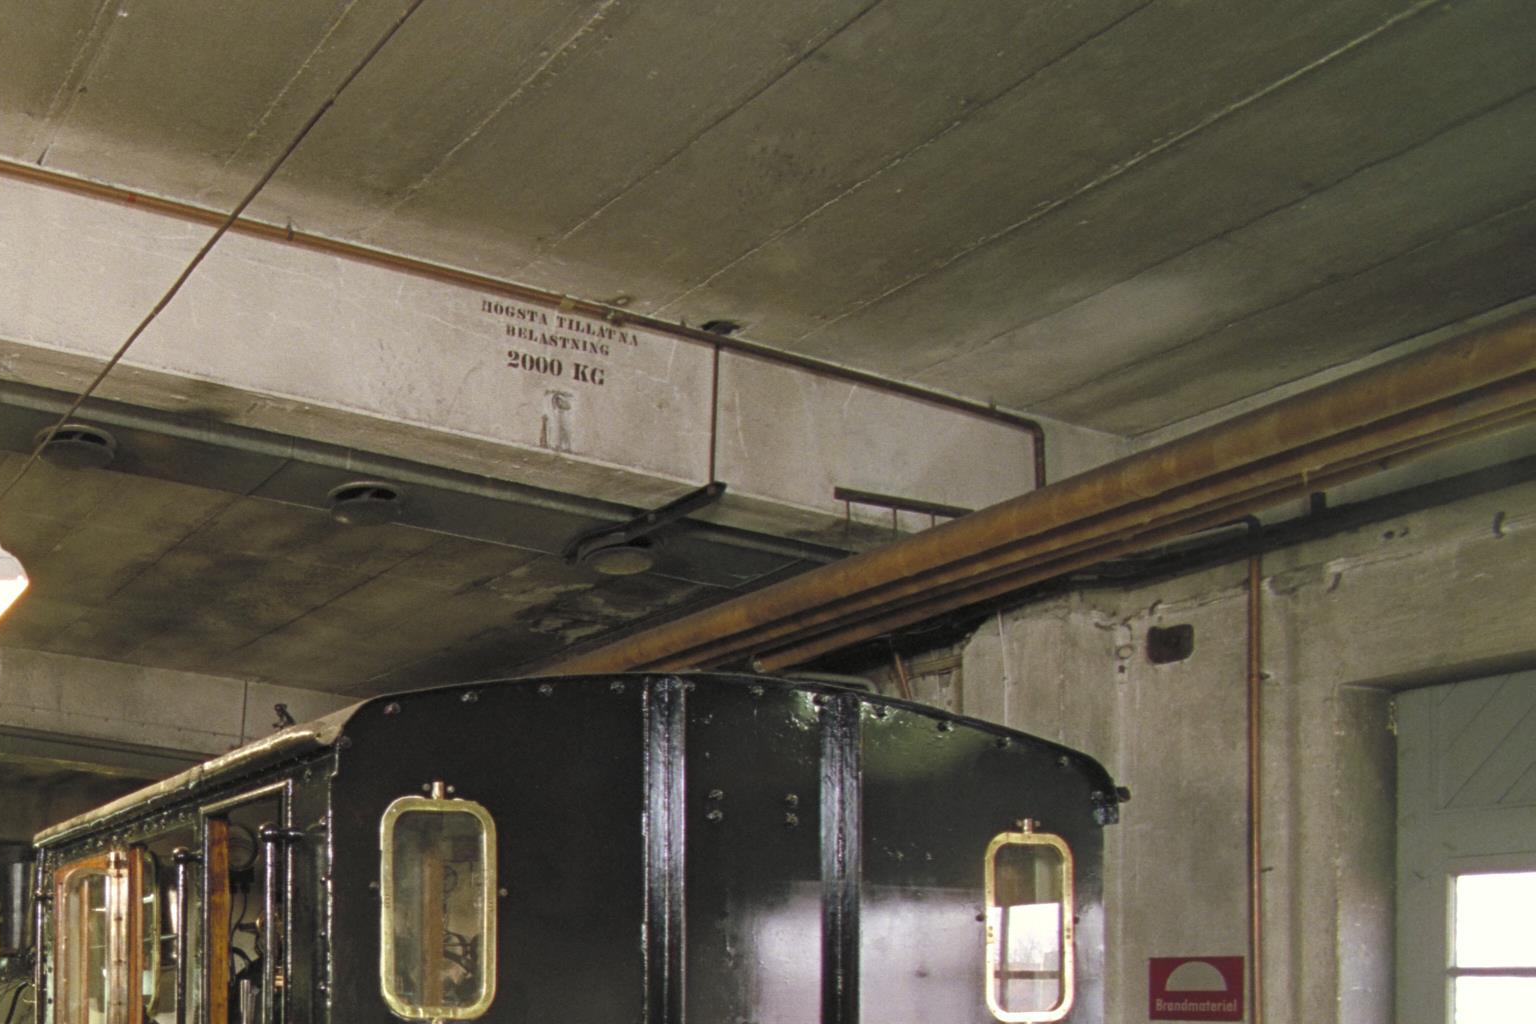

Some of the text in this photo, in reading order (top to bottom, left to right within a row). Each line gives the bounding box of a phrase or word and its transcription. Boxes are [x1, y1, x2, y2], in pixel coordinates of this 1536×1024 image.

[506, 324, 610, 356] BELASTNING
[507, 350, 605, 386] 2000 KG
[1155, 998, 1237, 1012] Brandmateriel
